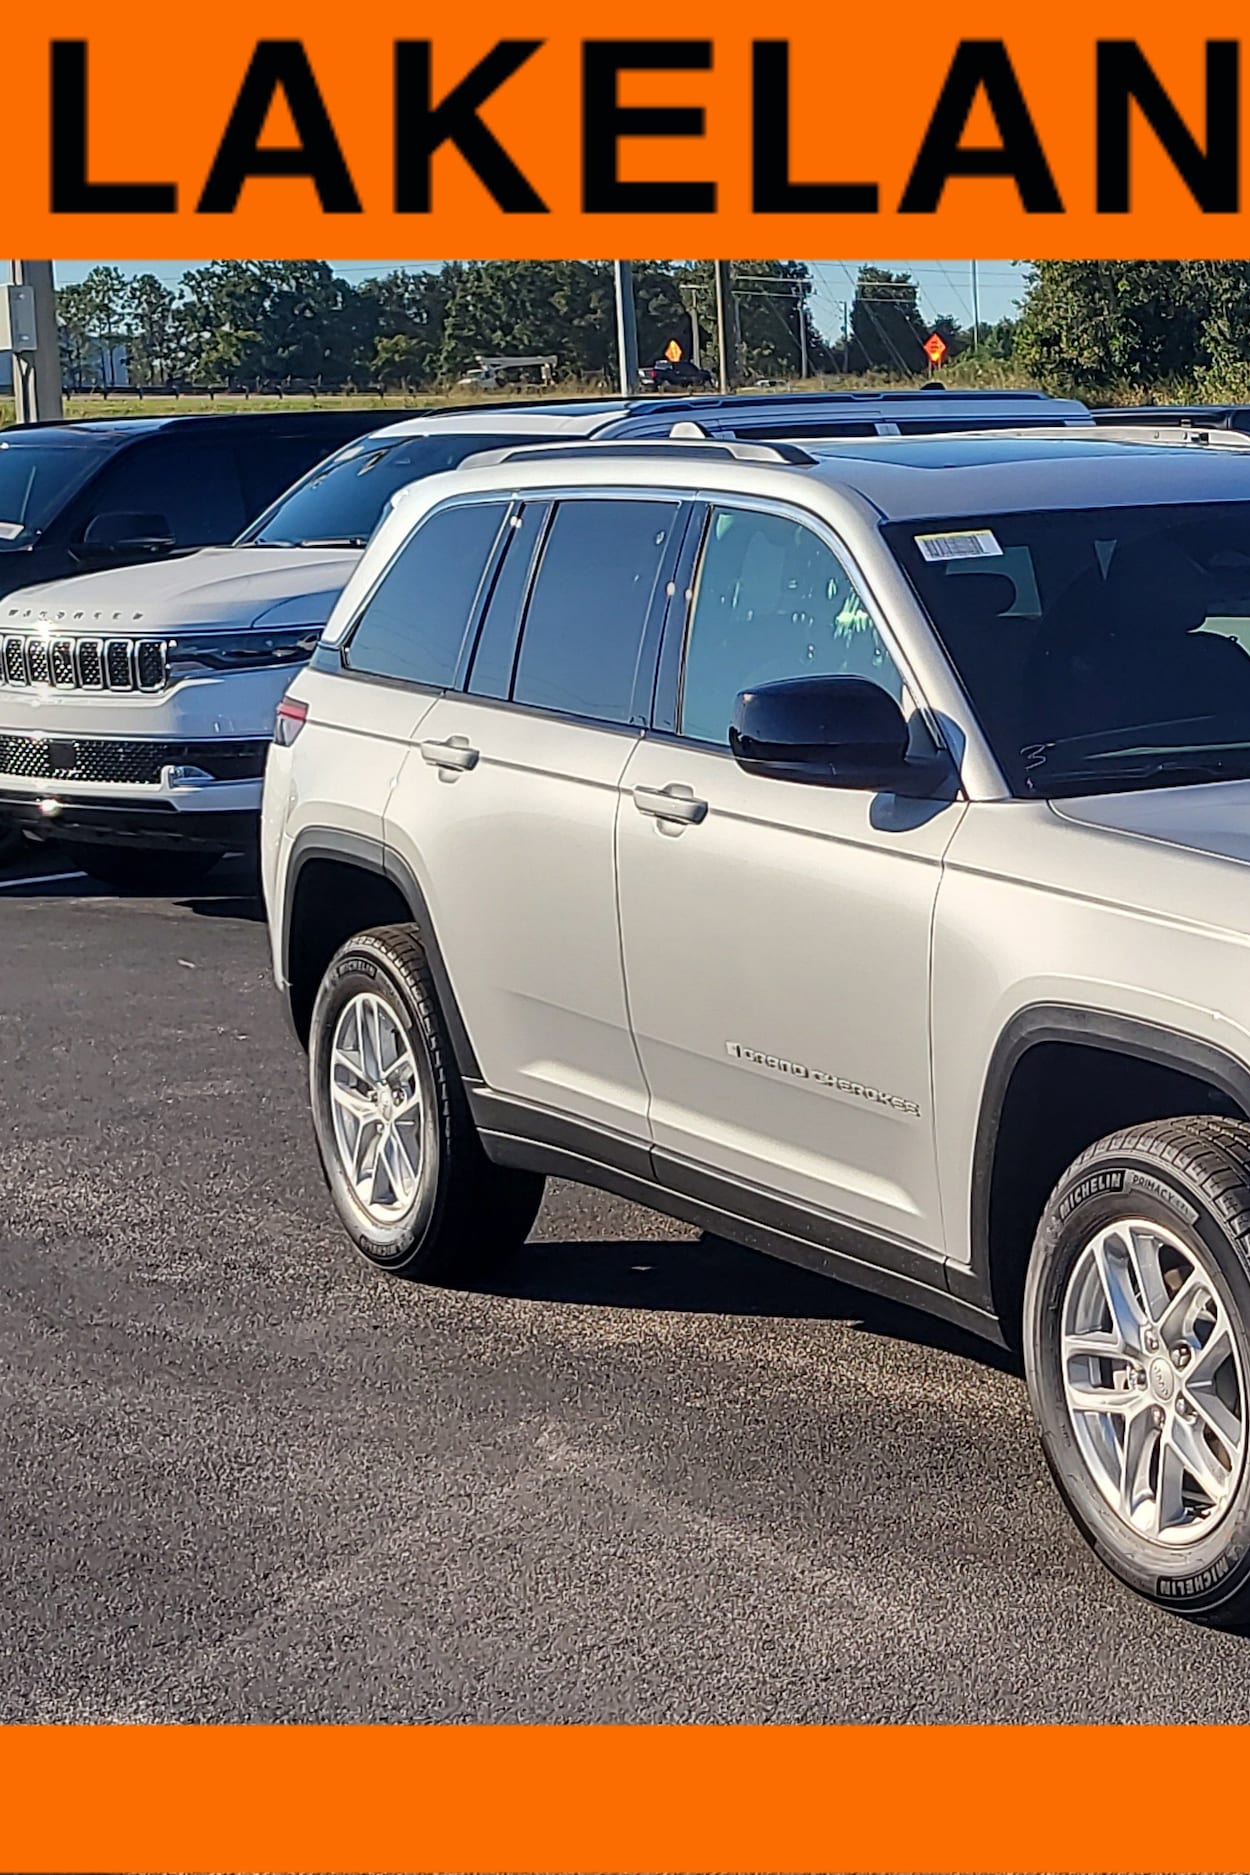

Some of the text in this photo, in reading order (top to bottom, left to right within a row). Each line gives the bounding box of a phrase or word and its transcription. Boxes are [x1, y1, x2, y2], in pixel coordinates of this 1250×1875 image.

[743, 1048, 921, 1118] GRAND CHEROKEE
[1059, 1172, 1174, 1220] MICHELIN PRIMACY
[1160, 1556, 1229, 1596] MICHELIN
